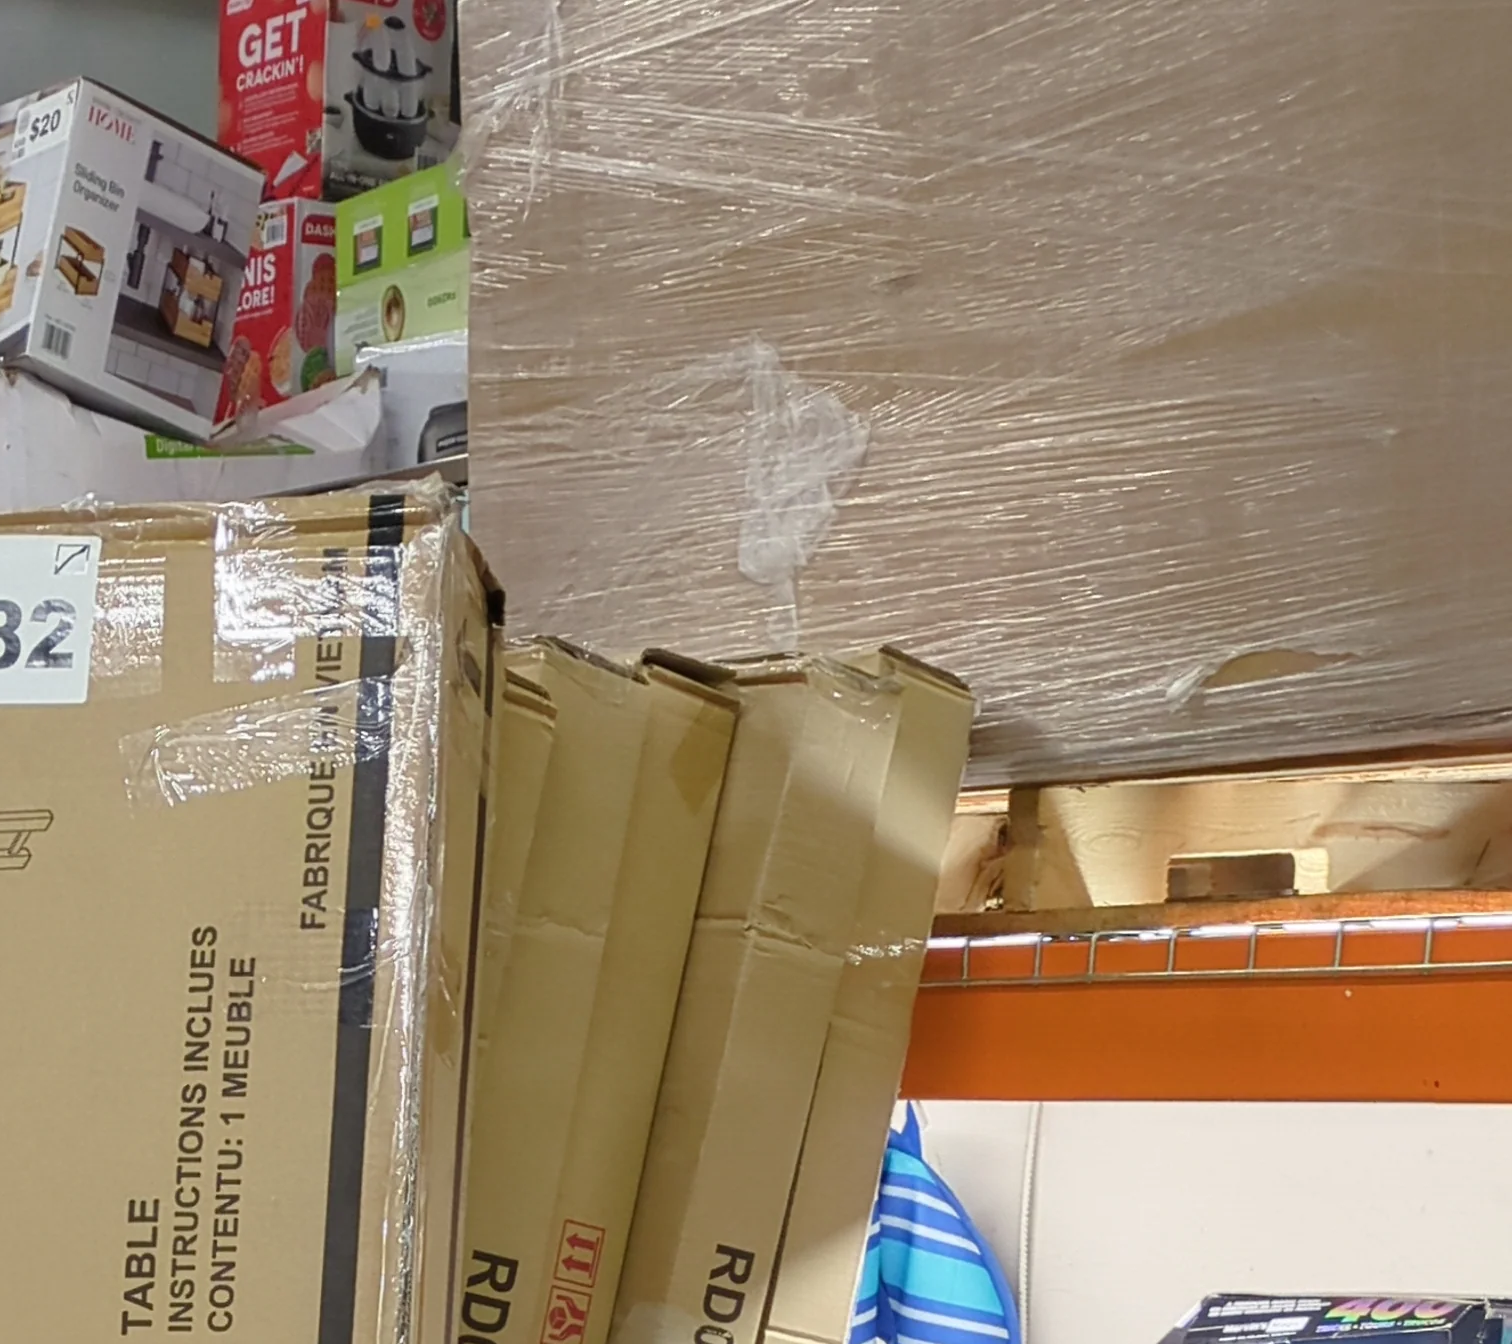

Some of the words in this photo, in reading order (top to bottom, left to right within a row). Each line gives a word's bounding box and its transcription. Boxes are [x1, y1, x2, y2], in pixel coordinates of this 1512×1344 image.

[238, 7, 308, 67] GET
[236, 54, 305, 92] CRACKIN'!
[30, 109, 61, 141] $20
[88, 106, 136, 143] HOME
[72, 180, 121, 213] Organizer
[75, 163, 107, 193] Sliding
[108, 181, 126, 199] Bin
[241, 253, 276, 287] NIS
[237, 287, 275, 312] ORE!
[300, 761, 336, 931] FABRIQUE
[184, 924, 219, 1073] INCLUES
[223, 956, 257, 1100] MEUBLE
[224, 1110, 246, 1129] 1
[167, 1083, 209, 1334] INSTRUCTIONS
[207, 1137, 246, 1334] CONTENTU:
[120, 1198, 160, 1337] TABLE
[1325, 1298, 1460, 1324] 400
